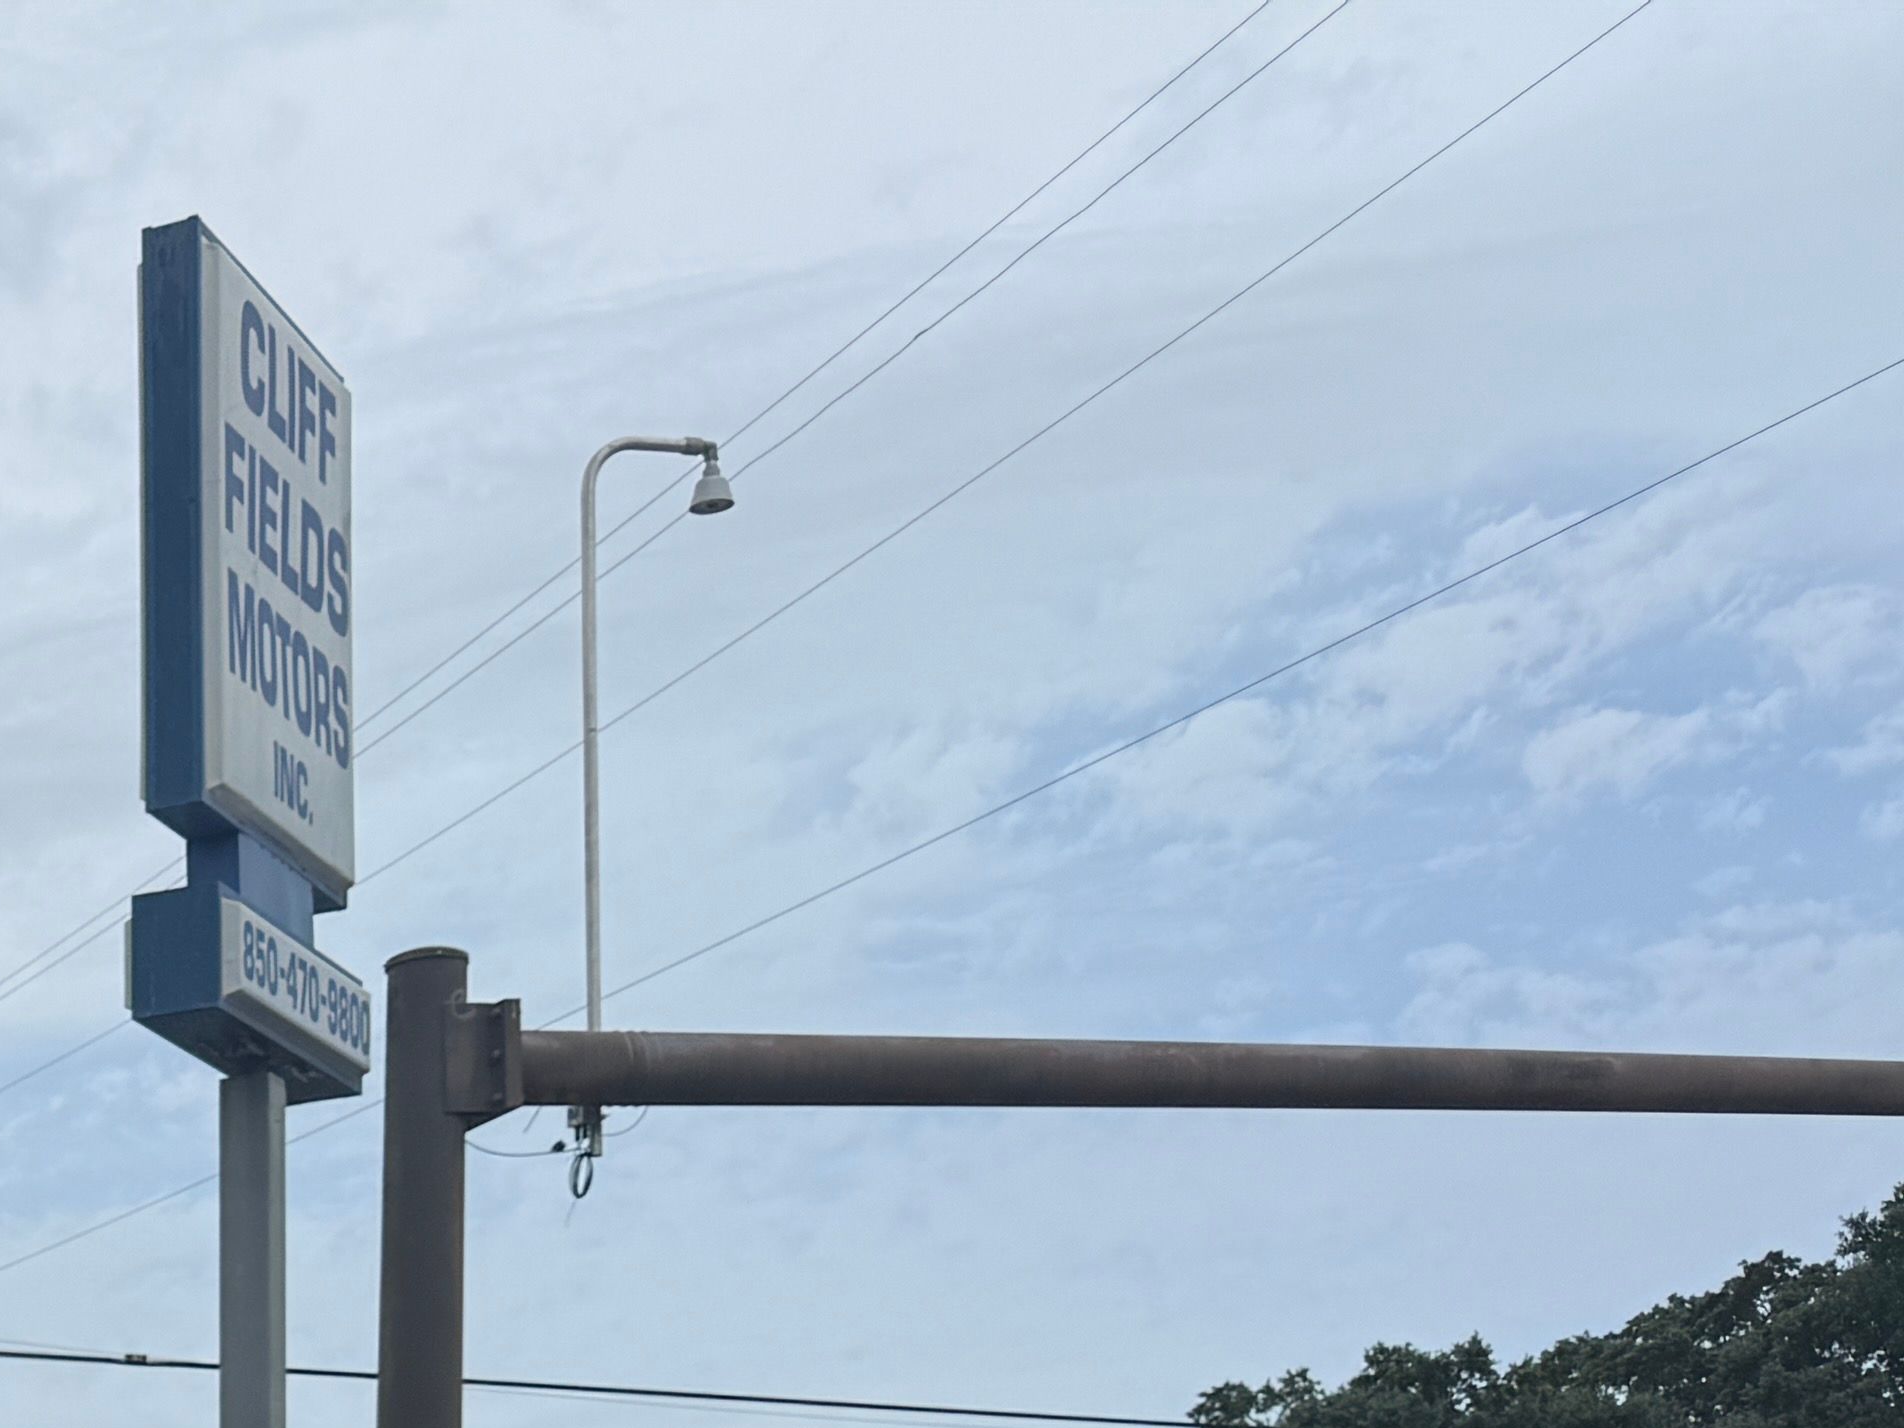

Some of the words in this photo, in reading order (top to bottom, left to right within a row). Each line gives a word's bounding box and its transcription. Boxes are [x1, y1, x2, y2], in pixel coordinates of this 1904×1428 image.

[241, 300, 337, 487] CLIFF
[225, 421, 350, 638] FIELDS
[228, 566, 350, 770] MOTORS
[273, 739, 314, 827] INC.
[243, 920, 371, 1058] 850-470-9800
